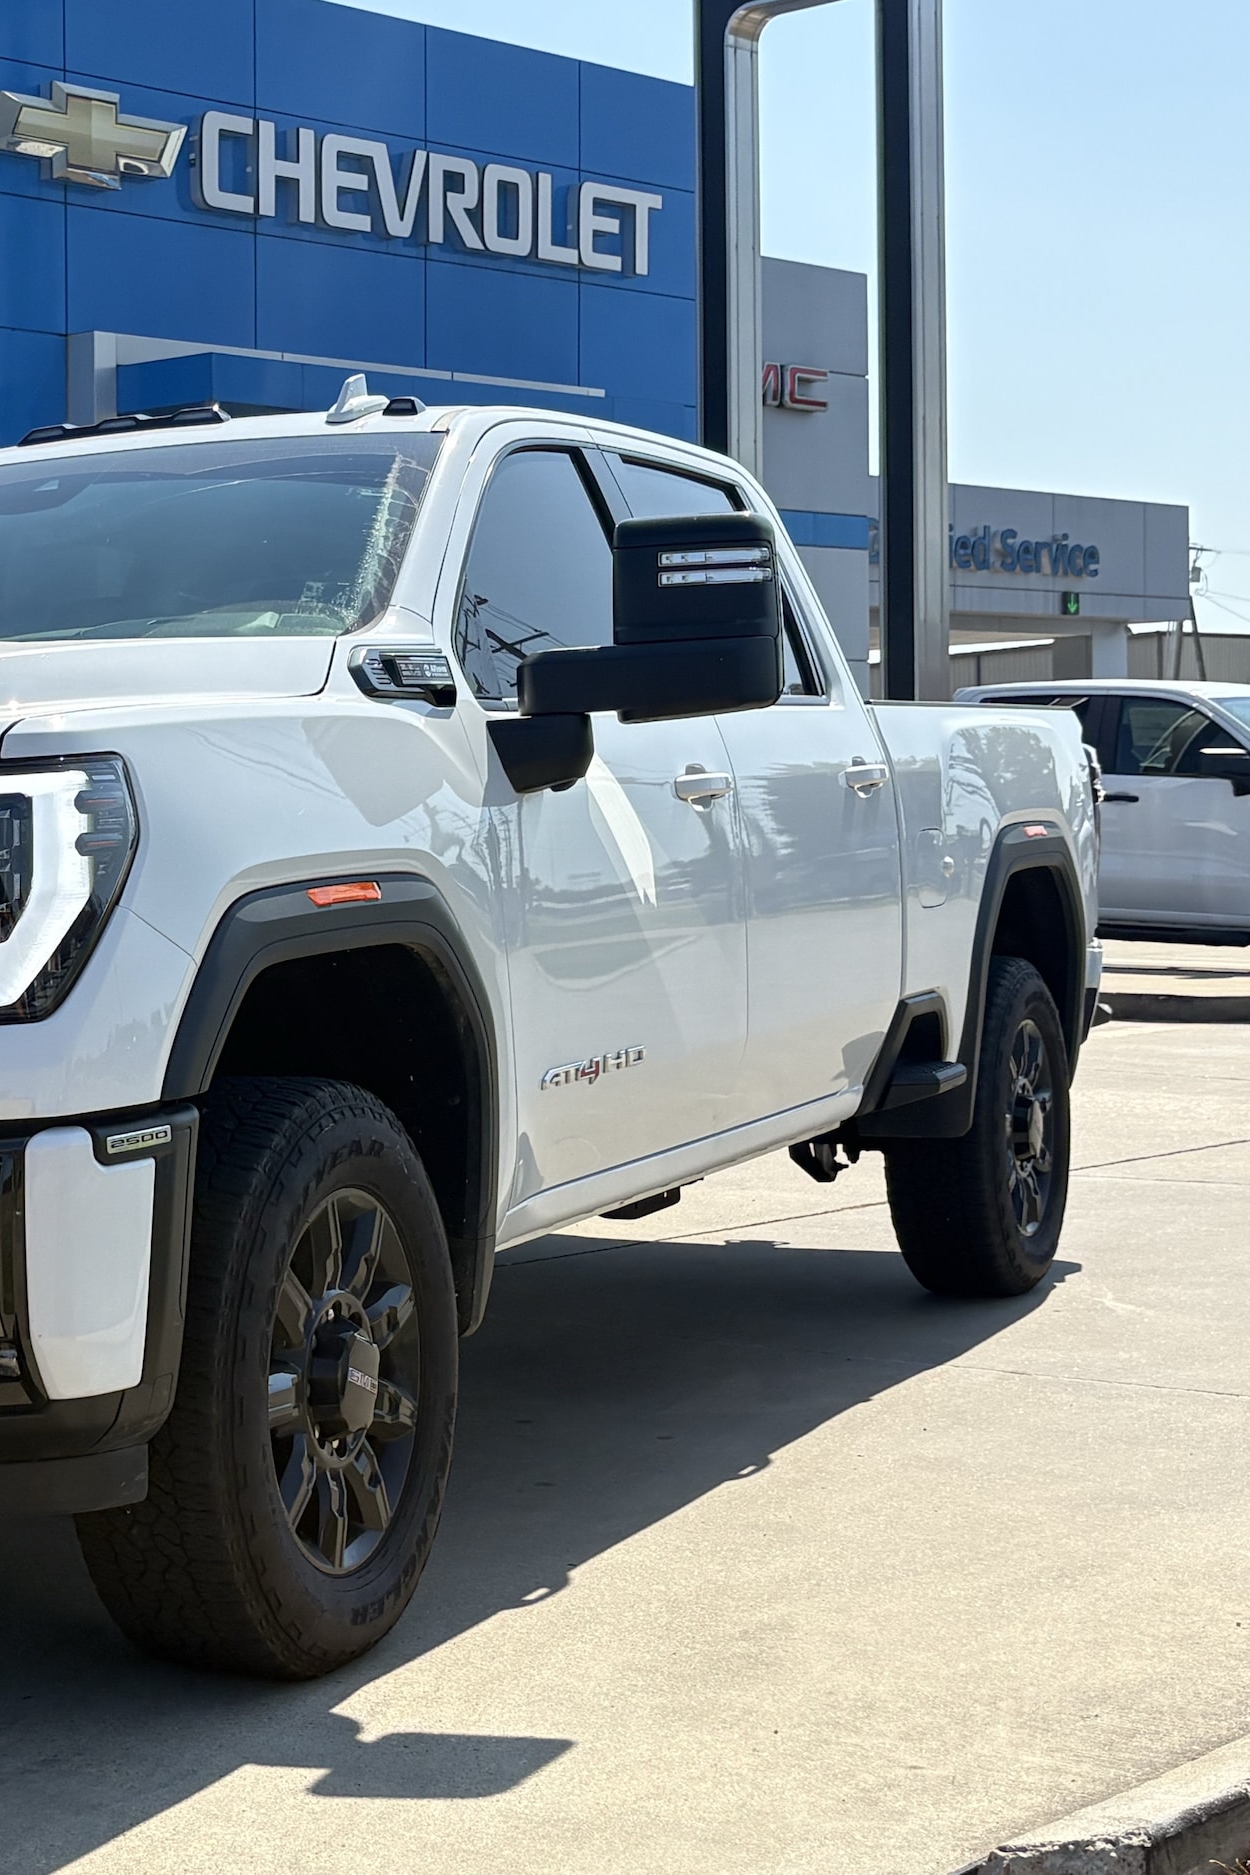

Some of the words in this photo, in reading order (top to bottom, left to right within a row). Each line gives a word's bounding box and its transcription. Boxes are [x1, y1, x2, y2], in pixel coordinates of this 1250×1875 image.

[200, 110, 663, 276] CHEVROLET
[1000, 528, 1100, 577] Service
[111, 1130, 168, 1148] 2500
